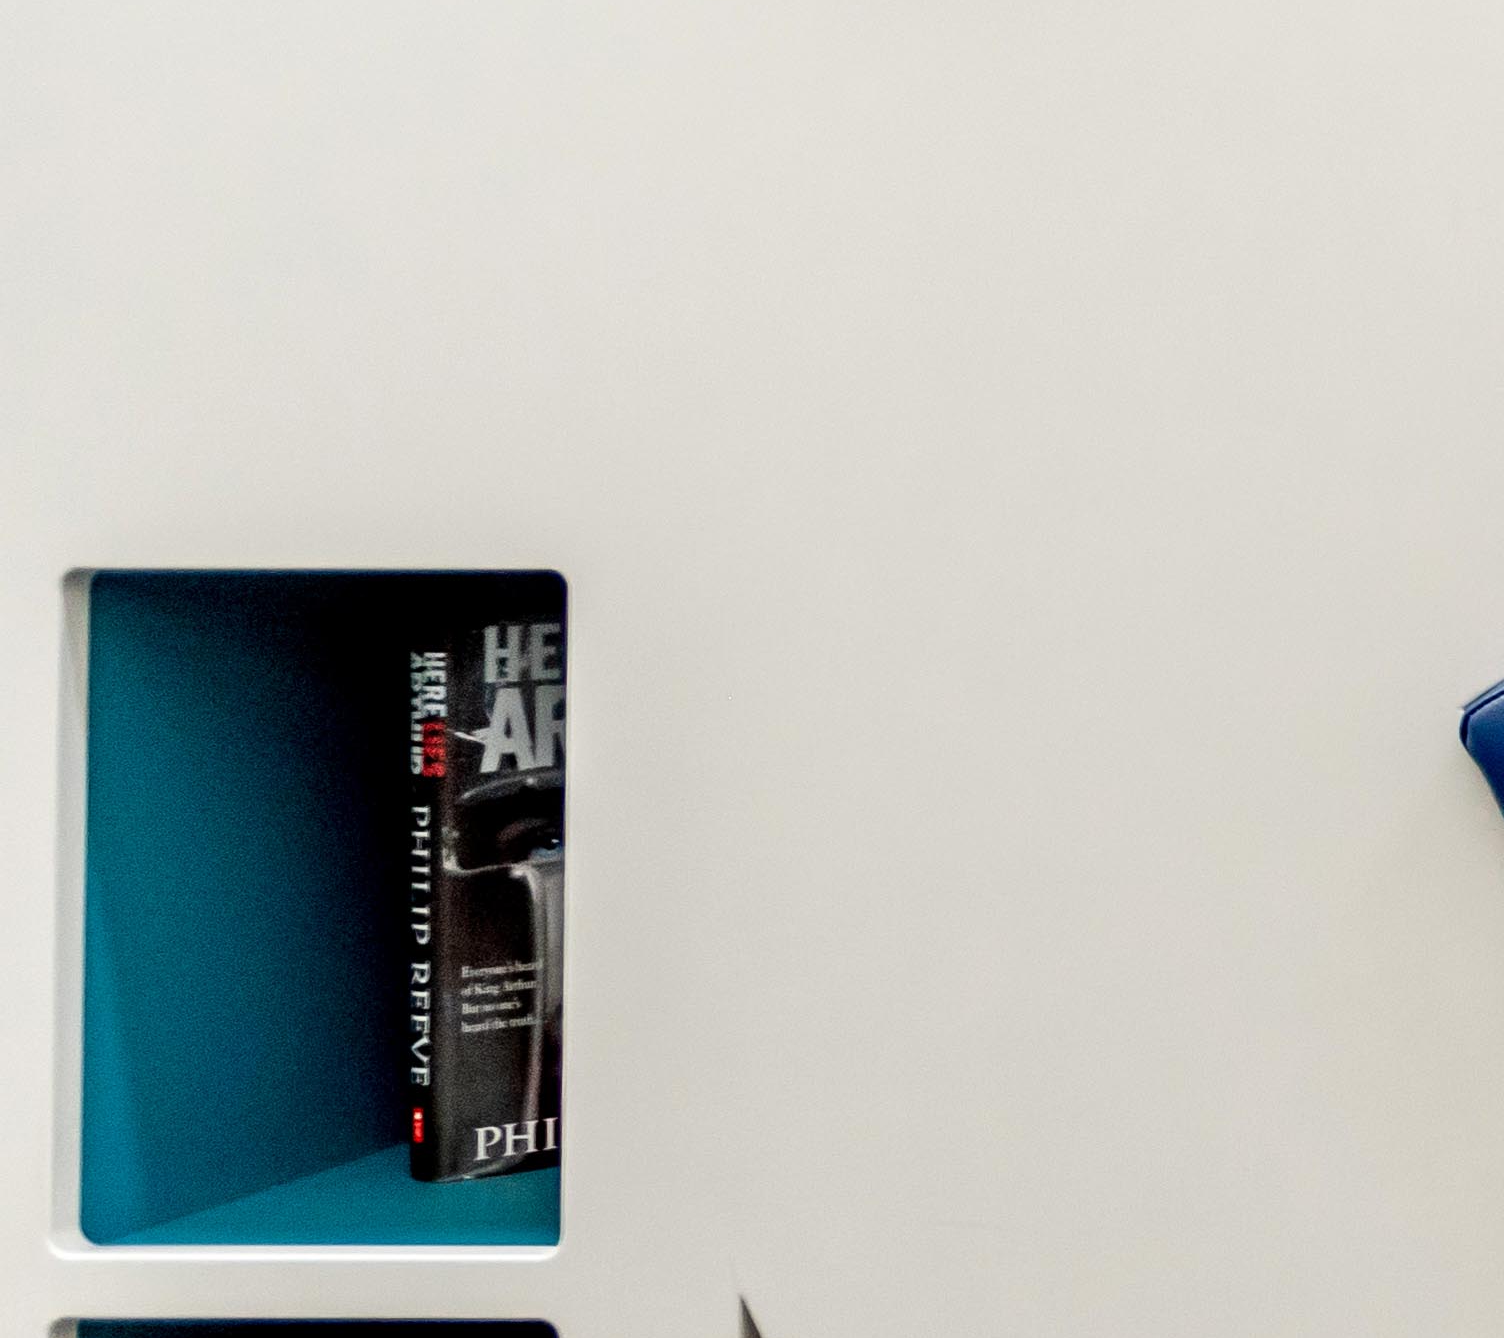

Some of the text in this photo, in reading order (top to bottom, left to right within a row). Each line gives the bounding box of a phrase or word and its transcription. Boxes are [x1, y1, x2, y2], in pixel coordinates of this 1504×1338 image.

[411, 805, 431, 945] PHILIP
[411, 962, 431, 1086] REEVE
[473, 1117, 559, 1161] PHI
